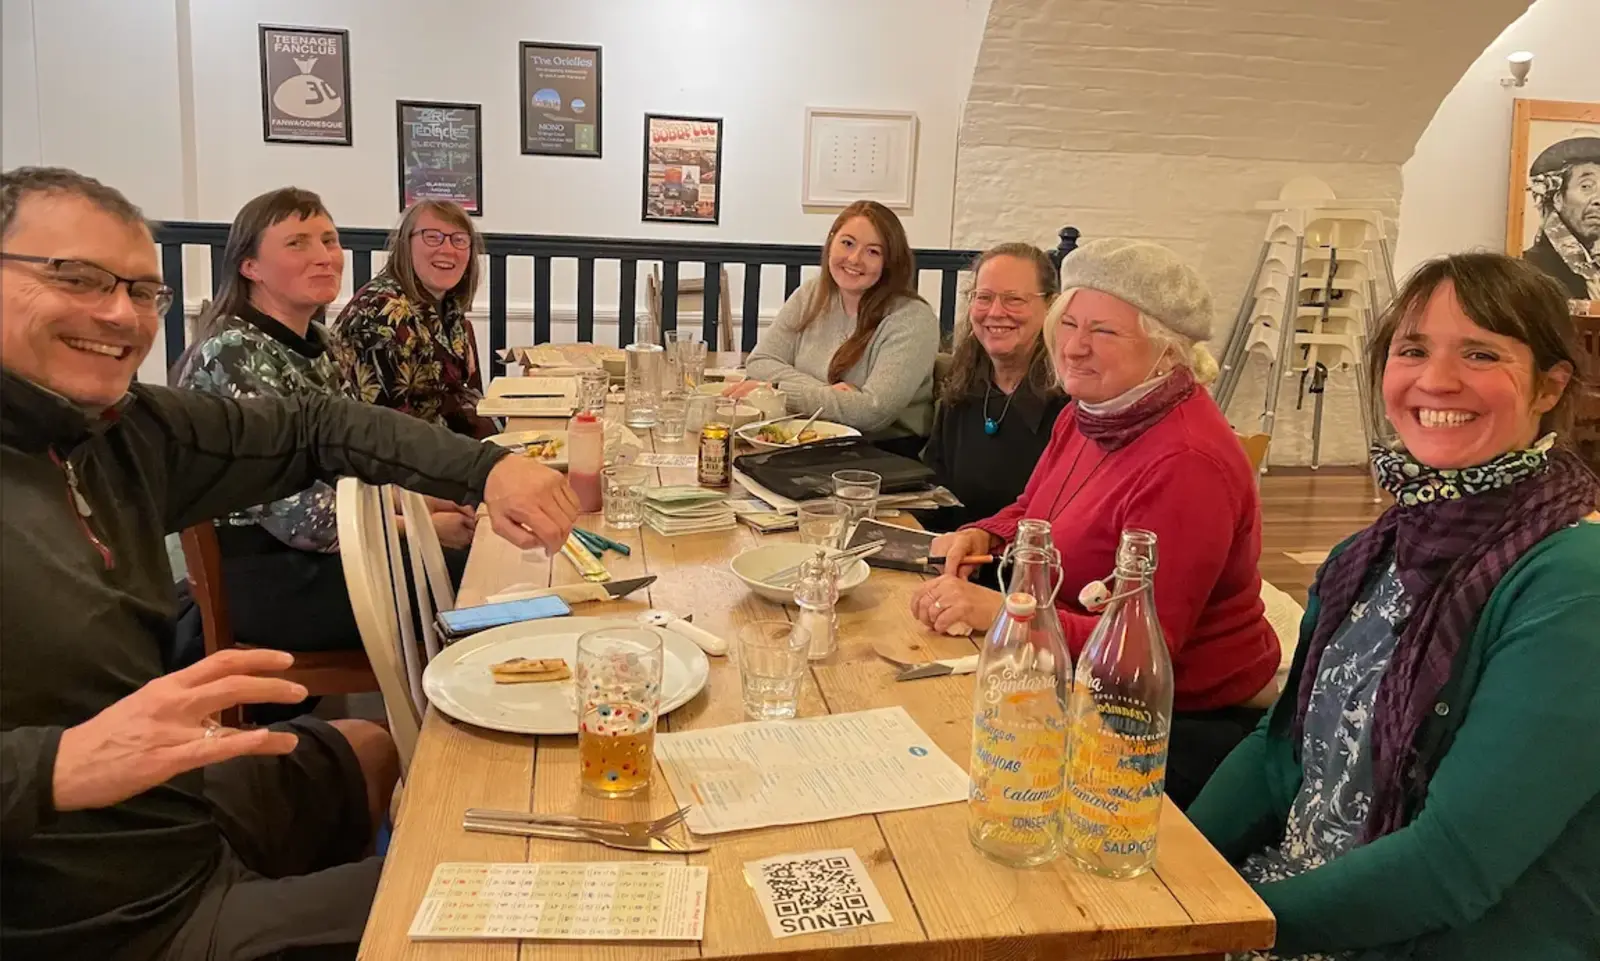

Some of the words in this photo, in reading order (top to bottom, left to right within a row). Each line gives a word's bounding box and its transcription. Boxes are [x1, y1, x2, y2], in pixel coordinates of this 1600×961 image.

[273, 35, 337, 47] TEENAGE
[274, 43, 337, 55] FANCLUB
[531, 55, 552, 65] The
[538, 123, 565, 132] MONO
[780, 910, 875, 933] MENUS
